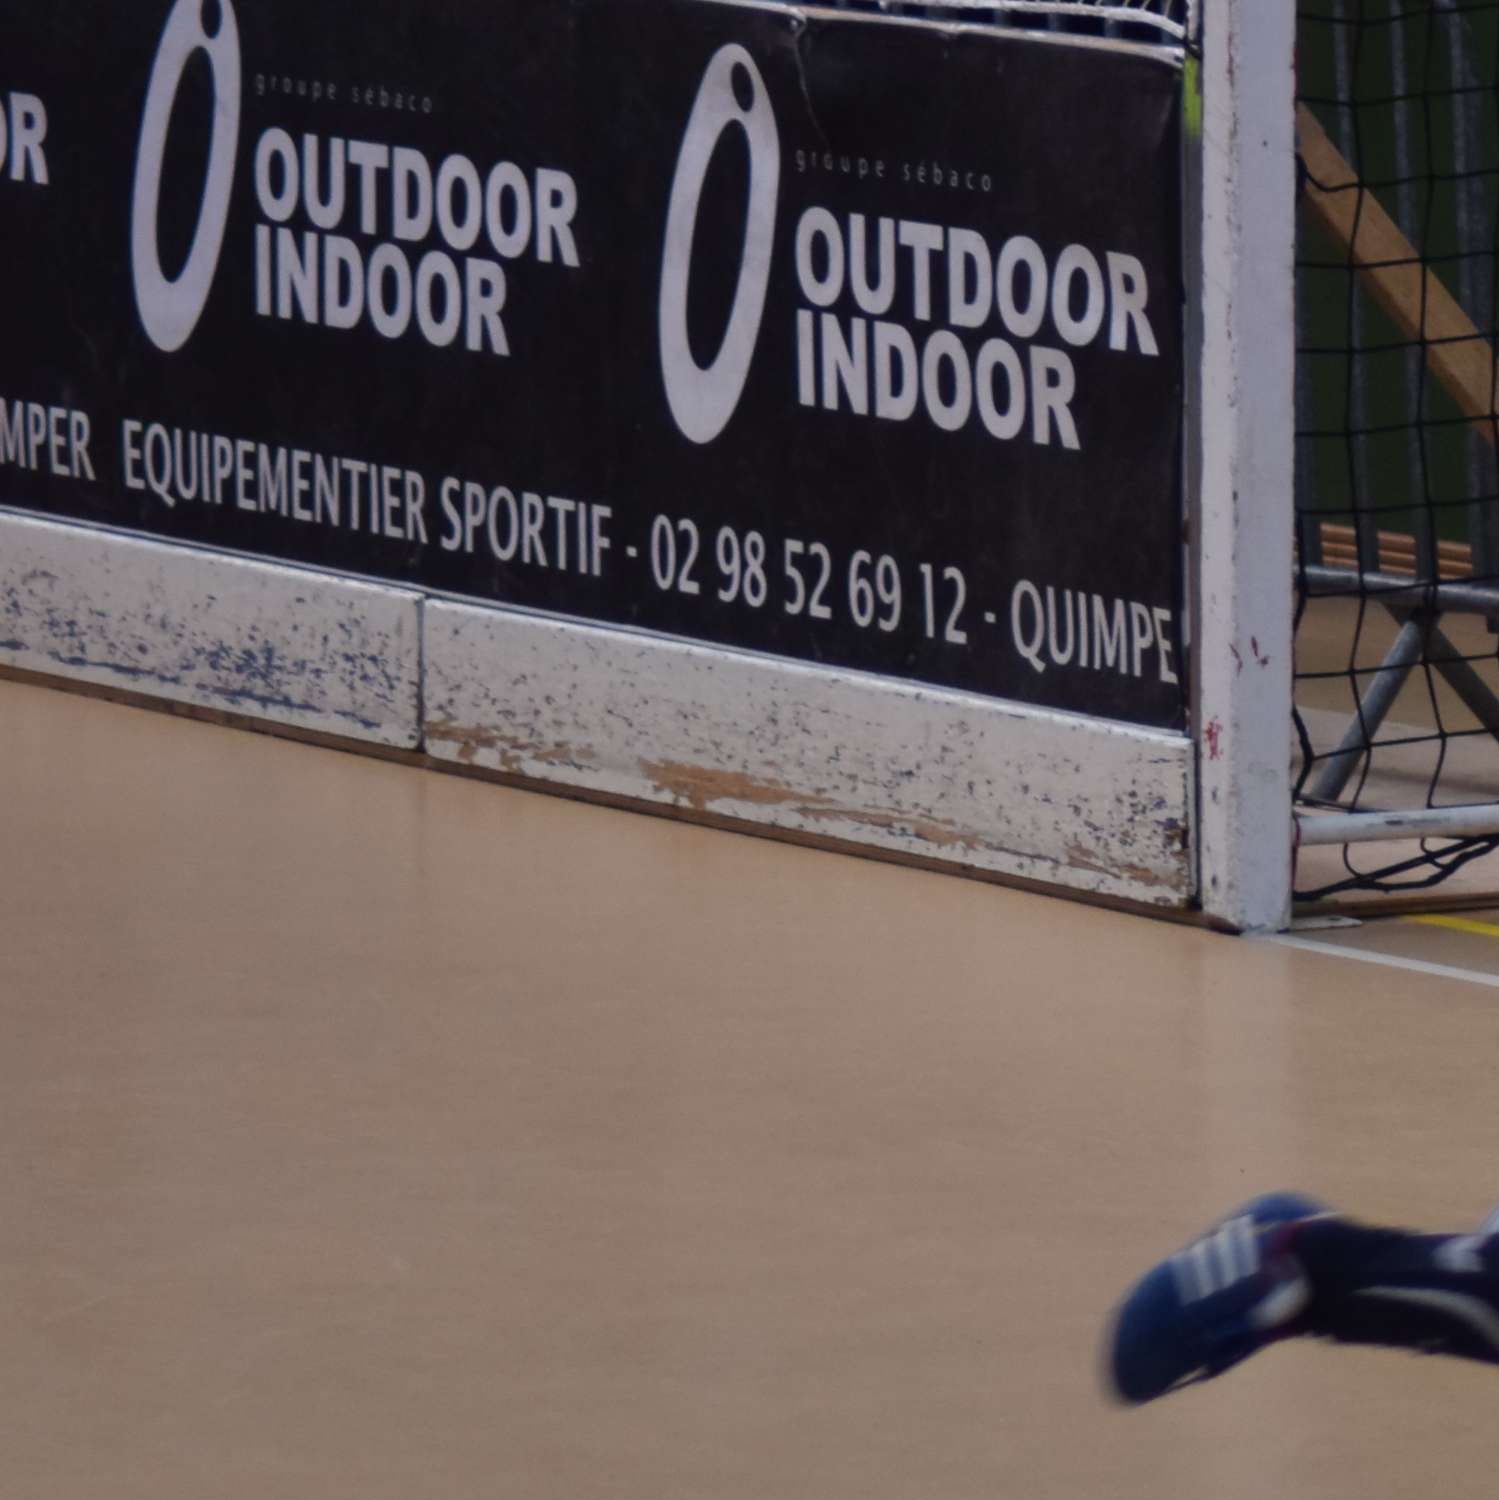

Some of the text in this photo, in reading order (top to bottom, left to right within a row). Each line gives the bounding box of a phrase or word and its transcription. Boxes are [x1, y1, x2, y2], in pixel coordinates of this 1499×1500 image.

[254, 127, 581, 268] OUTDOOR
[795, 149, 886, 179] groupe
[254, 223, 511, 357] INDOOR
[795, 206, 1160, 357] OUTDOOR
[796, 308, 1081, 451] INDOOR
[123, 419, 428, 545] EQUIPEMENTIER
[440, 476, 612, 578] SPORTIF
[651, 514, 700, 595] 02
[716, 525, 767, 609] 98
[784, 538, 832, 620] 52
[848, 549, 902, 633] 69
[919, 562, 968, 645] 12
